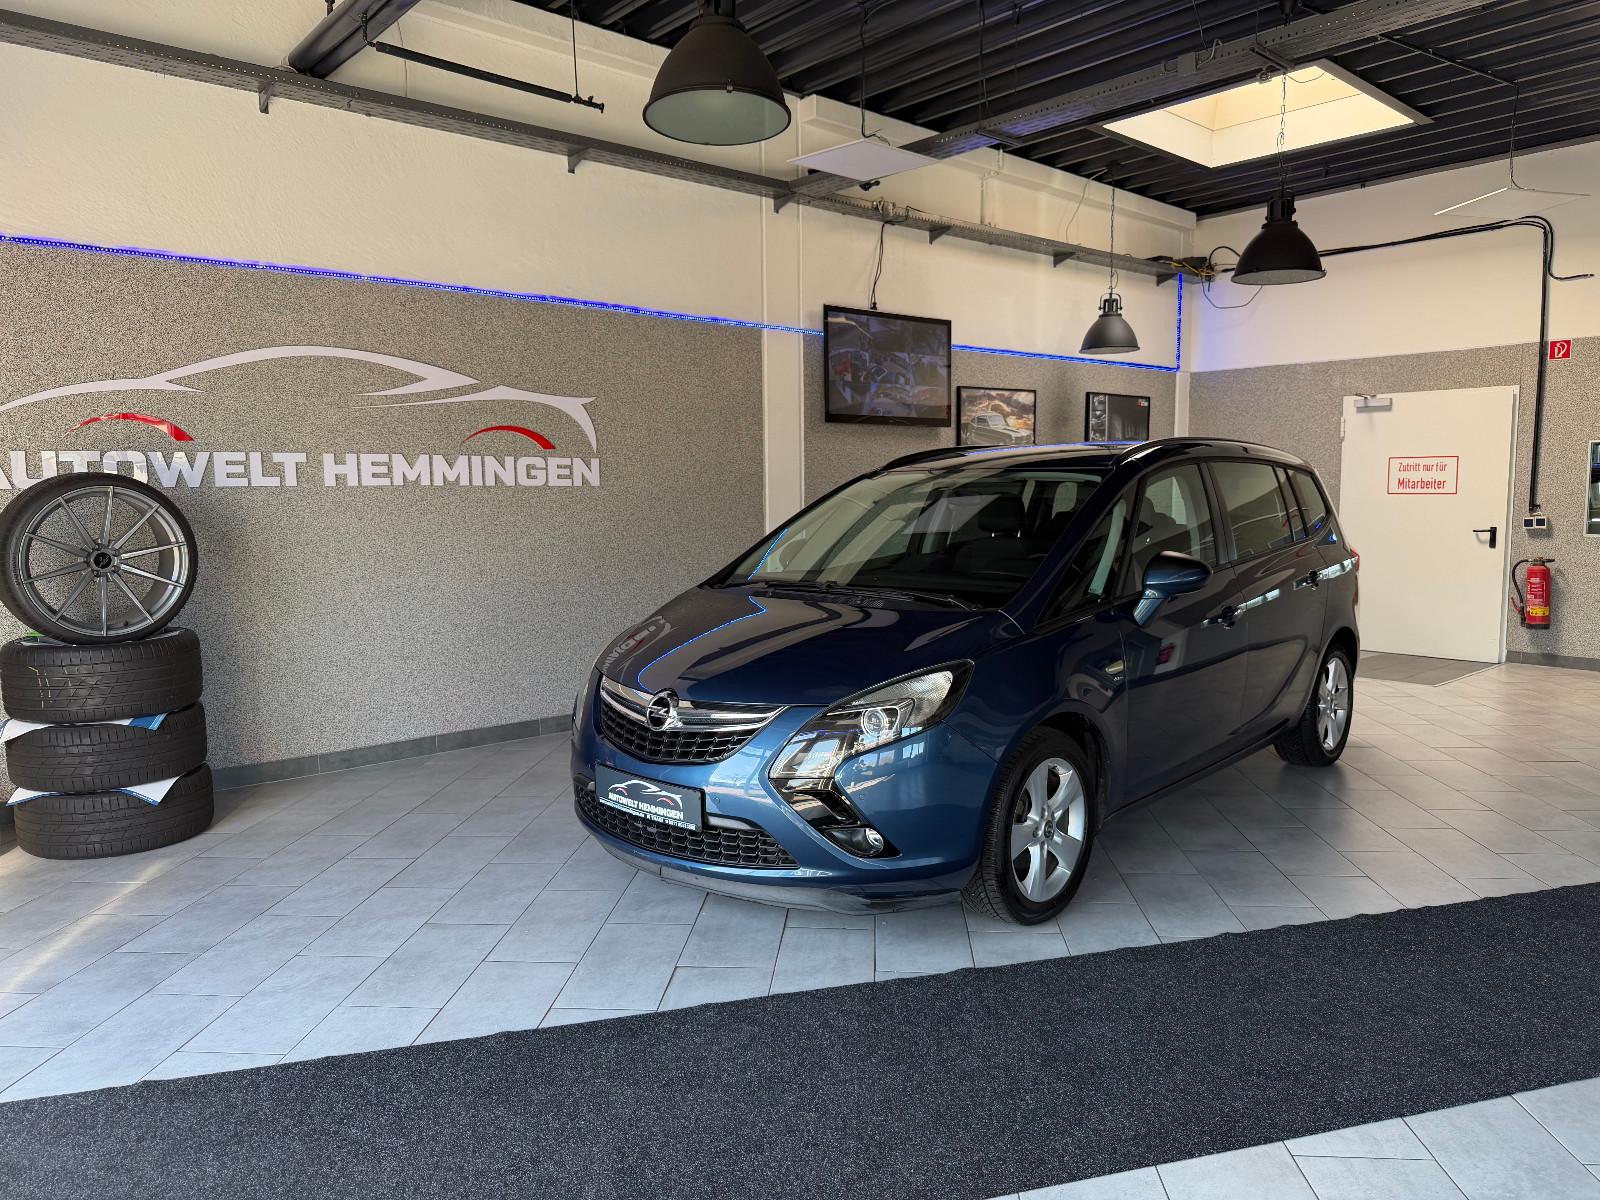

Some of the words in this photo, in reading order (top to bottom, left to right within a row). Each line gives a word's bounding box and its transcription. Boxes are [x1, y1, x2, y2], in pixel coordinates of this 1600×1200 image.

[0, 450, 307, 490] UTOWELT
[322, 453, 601, 487] HEMMINGEN
[1398, 462, 1421, 472] Zutritt
[1422, 463, 1434, 472] nur
[1435, 461, 1448, 472] für
[1397, 477, 1447, 490] Mitarbeiter
[608, 792, 638, 808] AUTOWELT
